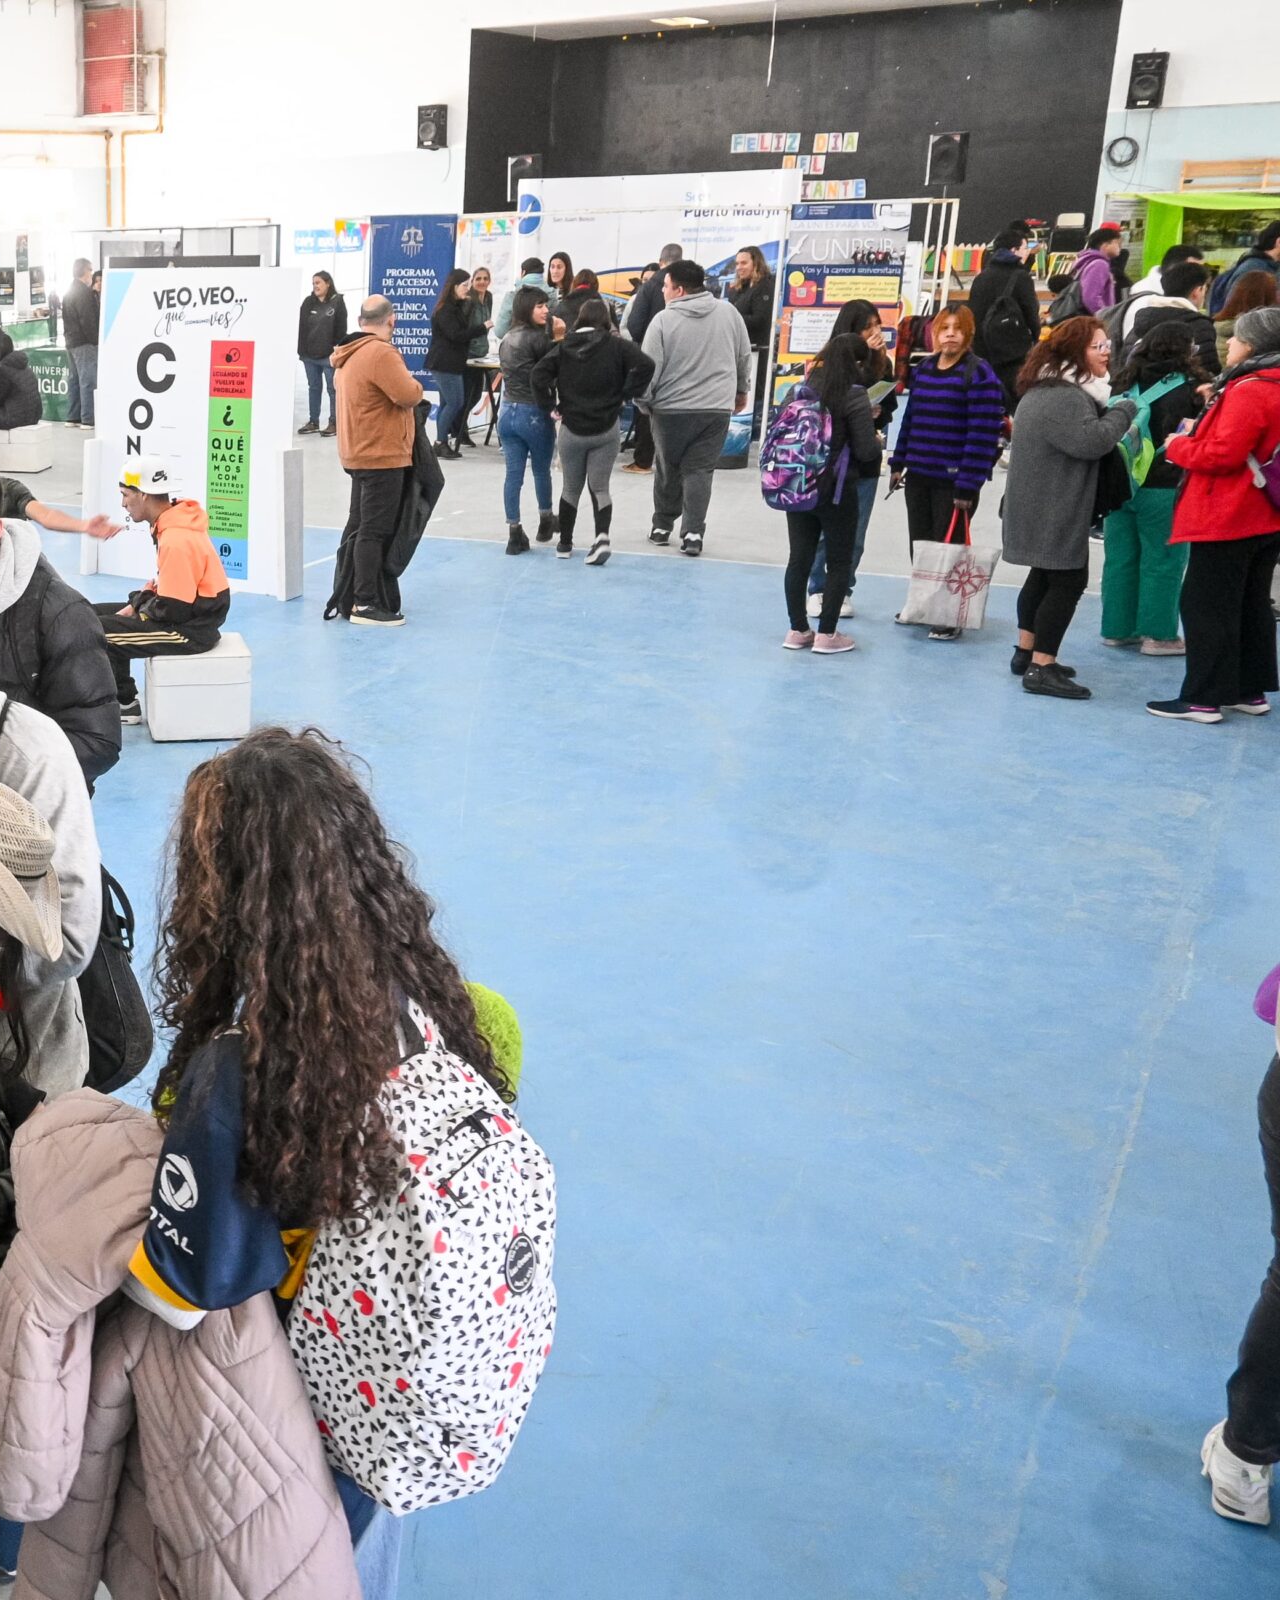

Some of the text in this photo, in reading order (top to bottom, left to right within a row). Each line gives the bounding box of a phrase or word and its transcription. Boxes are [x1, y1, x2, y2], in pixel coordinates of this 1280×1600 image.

[733, 133, 856, 152] FELIZ DIA
[786, 155, 821, 173] DEL
[801, 179, 865, 198] IANTE
[386, 268, 435, 277] PROGRAMA
[802, 266, 815, 274] Vos
[857, 266, 901, 274] universitaria
[382, 278, 438, 287] DE ACCESO A
[383, 287, 436, 296] LA JUSTICIA.
[153, 286, 248, 311] VEO, VEO...
[392, 300, 427, 311] CLÍNICA
[136, 341, 177, 394] C
[128, 398, 154, 431] O
[126, 434, 141, 456] N
[212, 436, 244, 451] QUÉ
[211, 453, 244, 463] HACE
[213, 465, 241, 473] MOS
[217, 473, 237, 481] CON
